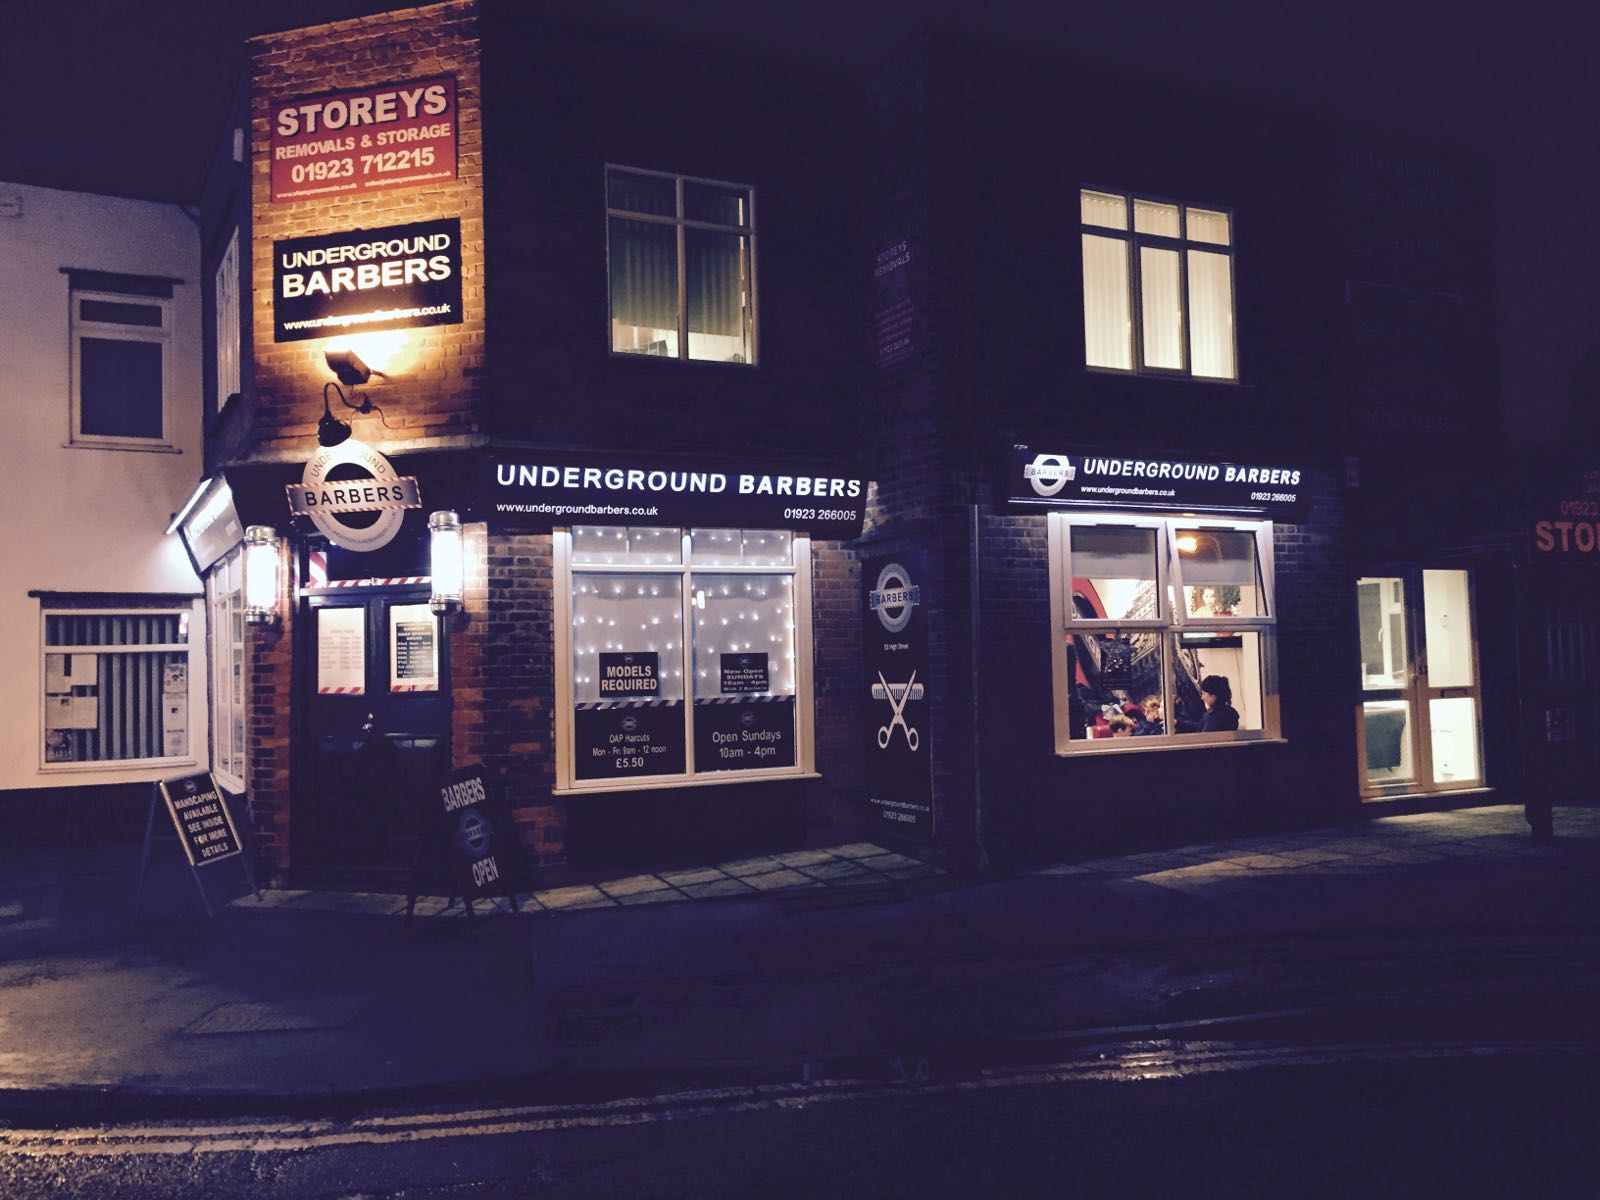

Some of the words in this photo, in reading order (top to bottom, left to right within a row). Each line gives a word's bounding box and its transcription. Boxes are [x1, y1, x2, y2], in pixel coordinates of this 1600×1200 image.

[277, 85, 446, 136] STOREYS
[275, 136, 355, 160] REMOVALS
[361, 134, 372, 148] &
[377, 123, 451, 146] STORAGE
[291, 158, 354, 183] 01923
[360, 147, 435, 174] 712215
[282, 234, 450, 269] UNDERGROUND
[282, 255, 451, 298] BARBERS
[1083, 458, 1220, 481] UNDERGROUND
[1225, 467, 1301, 485] BARBERS
[497, 464, 727, 493] UNDERGROUND
[738, 474, 861, 497] BARBERS
[305, 486, 404, 507] BARBERS
[1080, 486, 1176, 497] www.undergroundbarbers.co.uk
[1250, 491, 1271, 501] 01923
[496, 503, 658, 516] www.undergroundbarbers.co.uk
[783, 508, 816, 520] 01923
[817, 509, 857, 521] 266005
[1560, 500, 1598, 516] 01923
[876, 591, 913, 604] BARBERS
[607, 665, 652, 678] MODELS
[601, 678, 657, 691] REQUIRED
[609, 733, 623, 743] OAP
[712, 732, 738, 744] Open
[742, 729, 782, 743] Sundays
[593, 747, 607, 757] Mon
[622, 745, 636, 755] 9am
[643, 744, 649, 754] 12
[651, 745, 667, 754] noon
[719, 747, 744, 758] 10am
[754, 745, 776, 758] 4pm
[615, 756, 644, 769] £5.50
[441, 777, 486, 812] BARBERS
[183, 803, 219, 821] AVAILABLE
[187, 821, 202, 833] SEE
[193, 833, 209, 846] FOR
[201, 842, 229, 858] DETAILS
[472, 856, 499, 887] OPEN
